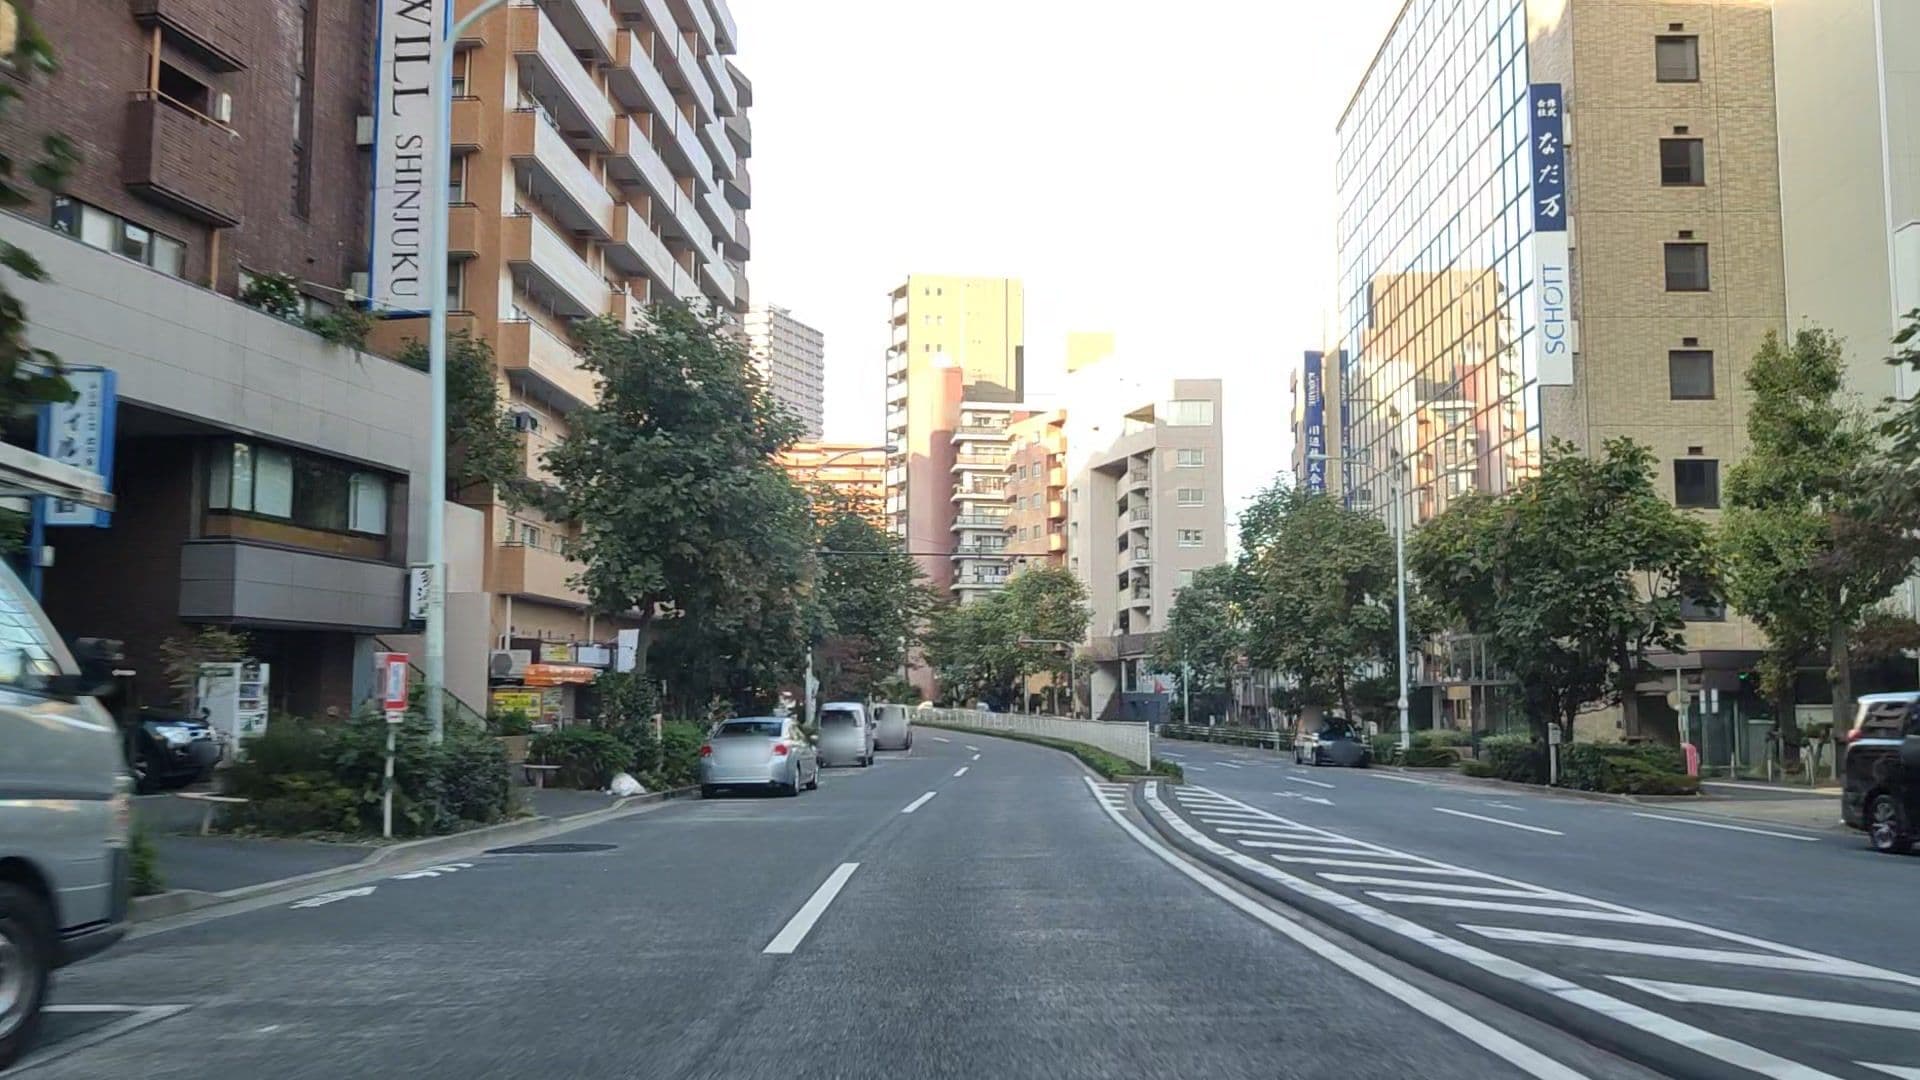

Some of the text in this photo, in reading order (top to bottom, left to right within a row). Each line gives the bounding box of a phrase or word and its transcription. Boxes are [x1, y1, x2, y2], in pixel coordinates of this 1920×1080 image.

[390, 0, 431, 297] WILL SHINJUKU
[1538, 131, 1562, 218] なだ万
[1542, 263, 1566, 355] SCHOTT
